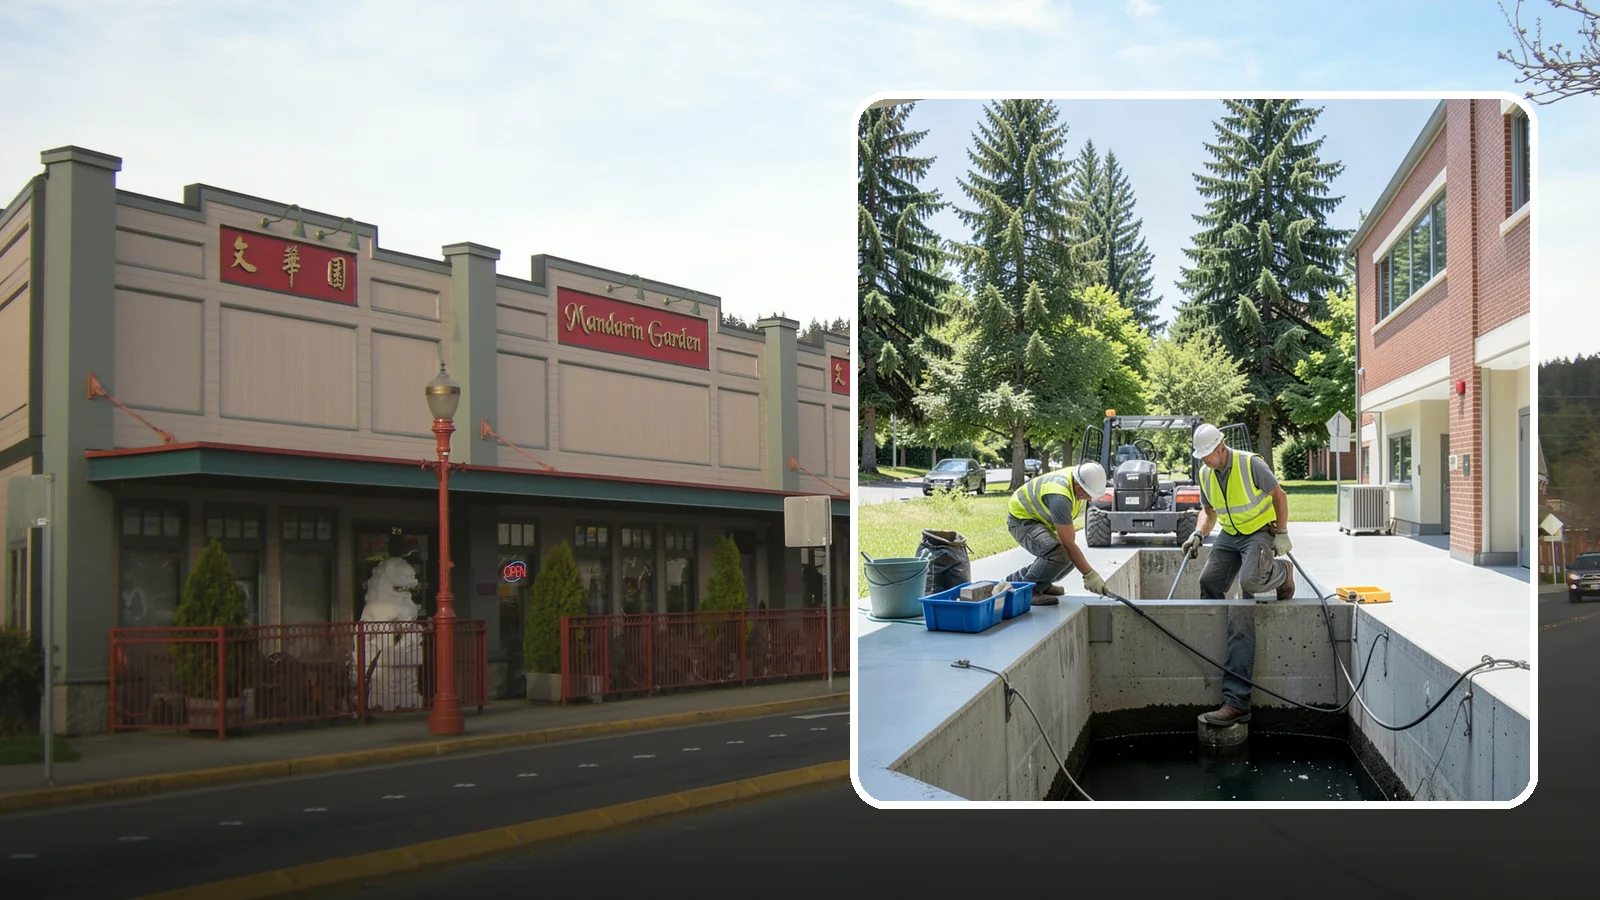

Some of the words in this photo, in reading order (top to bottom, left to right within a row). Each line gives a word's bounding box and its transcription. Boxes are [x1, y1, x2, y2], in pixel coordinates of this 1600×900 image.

[231, 236, 347, 291] 文華園
[564, 302, 644, 341] Mandarin
[647, 320, 702, 352] Garden
[503, 565, 527, 578] OPEN
